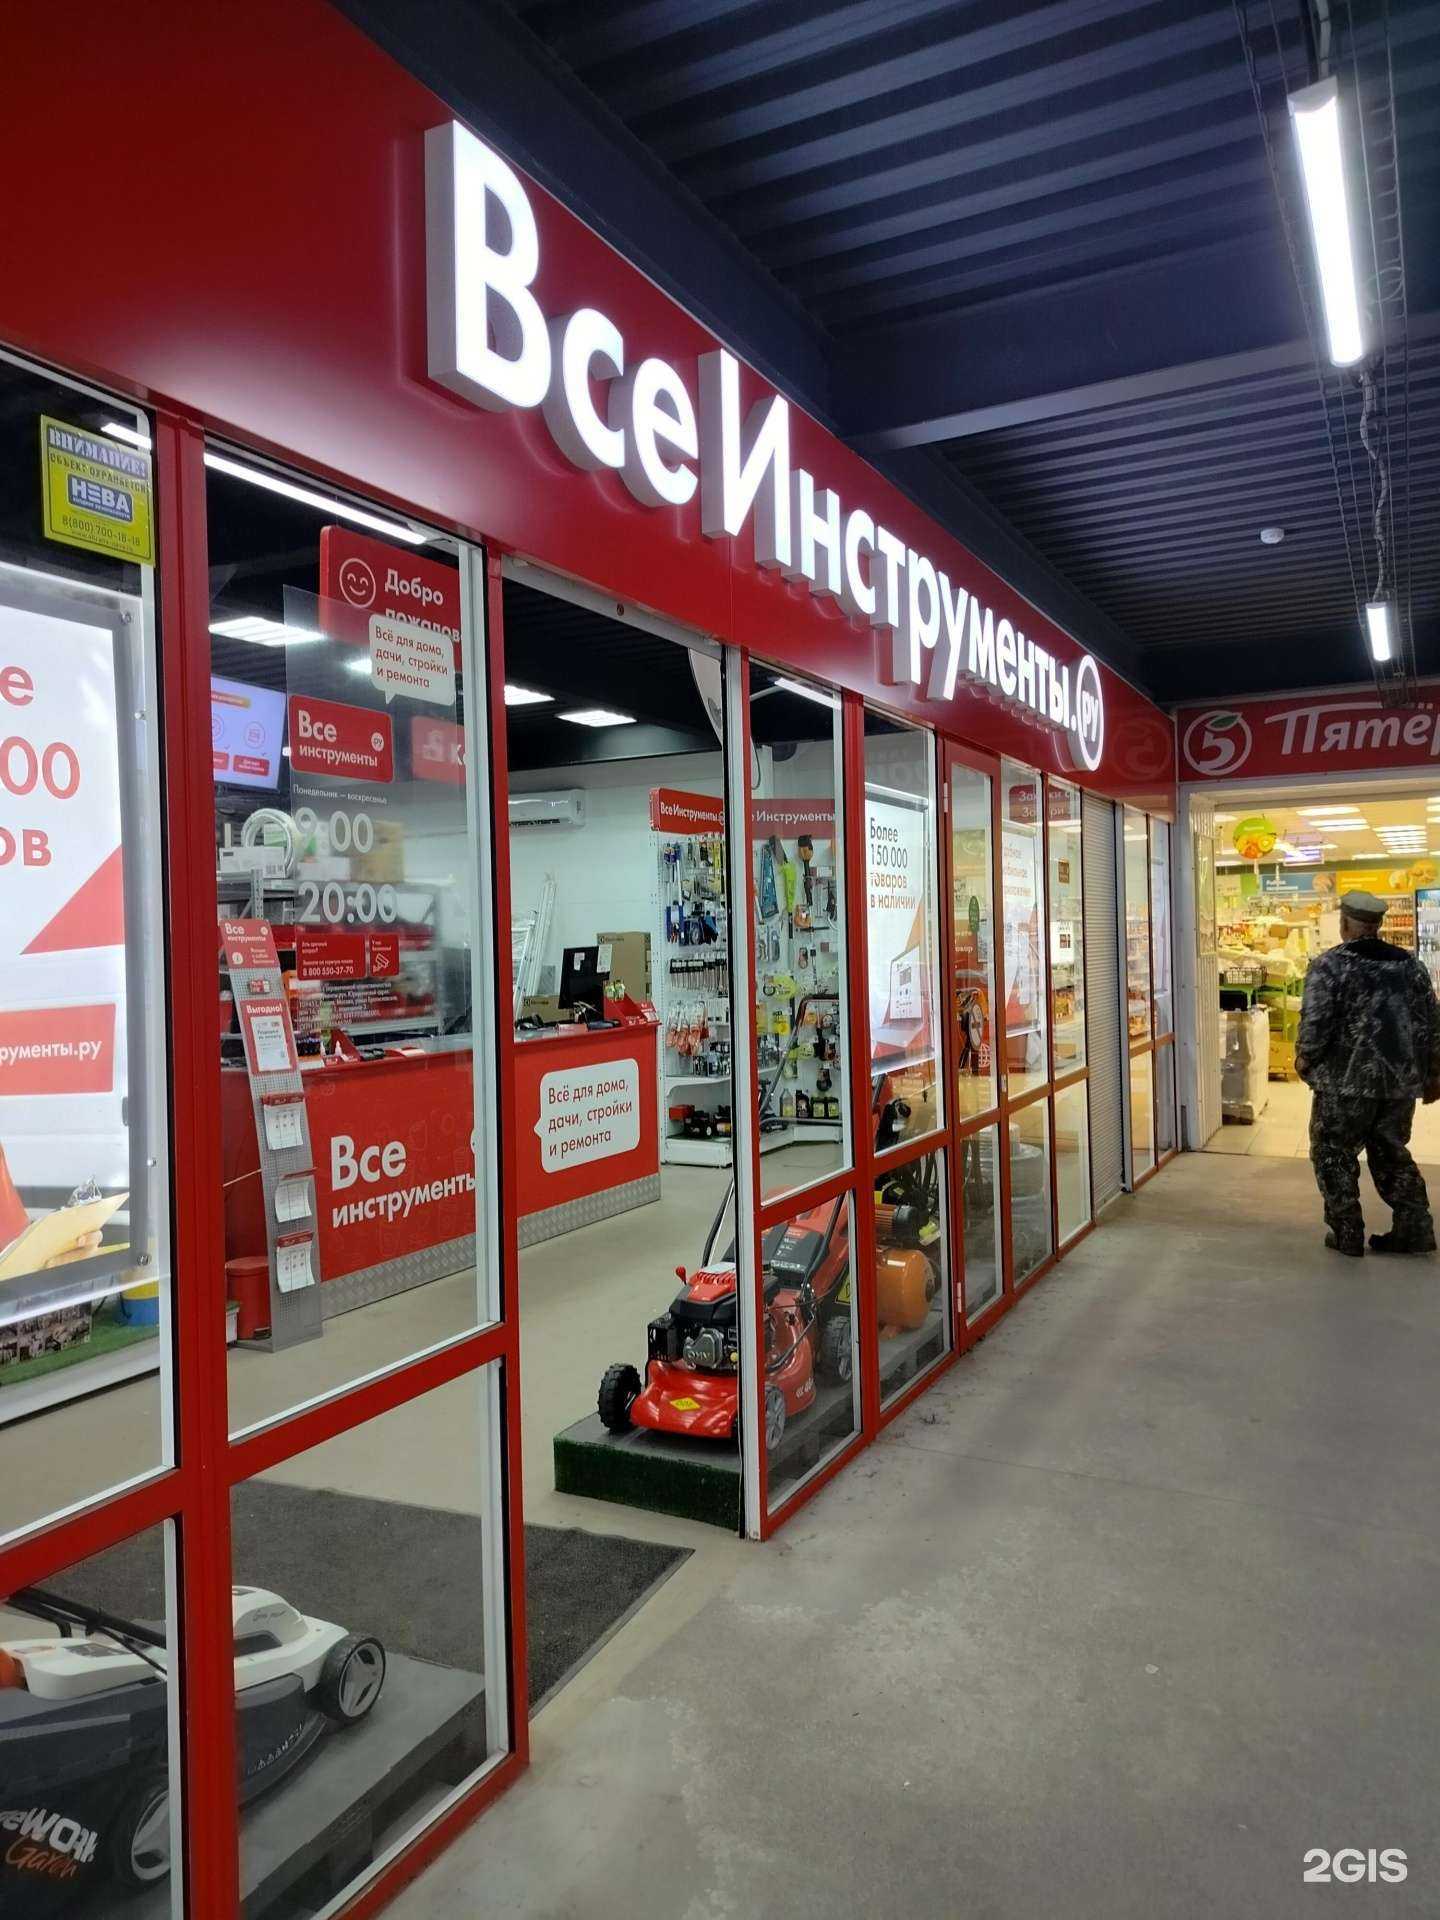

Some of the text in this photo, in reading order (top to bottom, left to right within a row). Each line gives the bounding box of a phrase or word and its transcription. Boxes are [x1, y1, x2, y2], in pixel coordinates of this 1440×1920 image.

[71, 477, 130, 512] НЕВА
[384, 567, 444, 608] Добро
[375, 625, 445, 658] Всё для дома,
[376, 648, 448, 675] дачи, стройки
[376, 665, 430, 689] и ремонта
[298, 709, 337, 743] Все
[1264, 702, 1440, 756] Пятё
[299, 745, 378, 767] инструменты
[752, 809, 836, 825] Инструменты
[870, 817, 898, 843] Более
[299, 881, 397, 923] 20:00
[225, 922, 245, 936] Все
[246, 1003, 283, 1015] Выгодно!
[548, 1079, 629, 1104] Всё для дома,
[548, 1100, 632, 1134] дачи, стройки
[549, 1130, 612, 1159] и ремонта
[331, 1135, 407, 1191] Все
